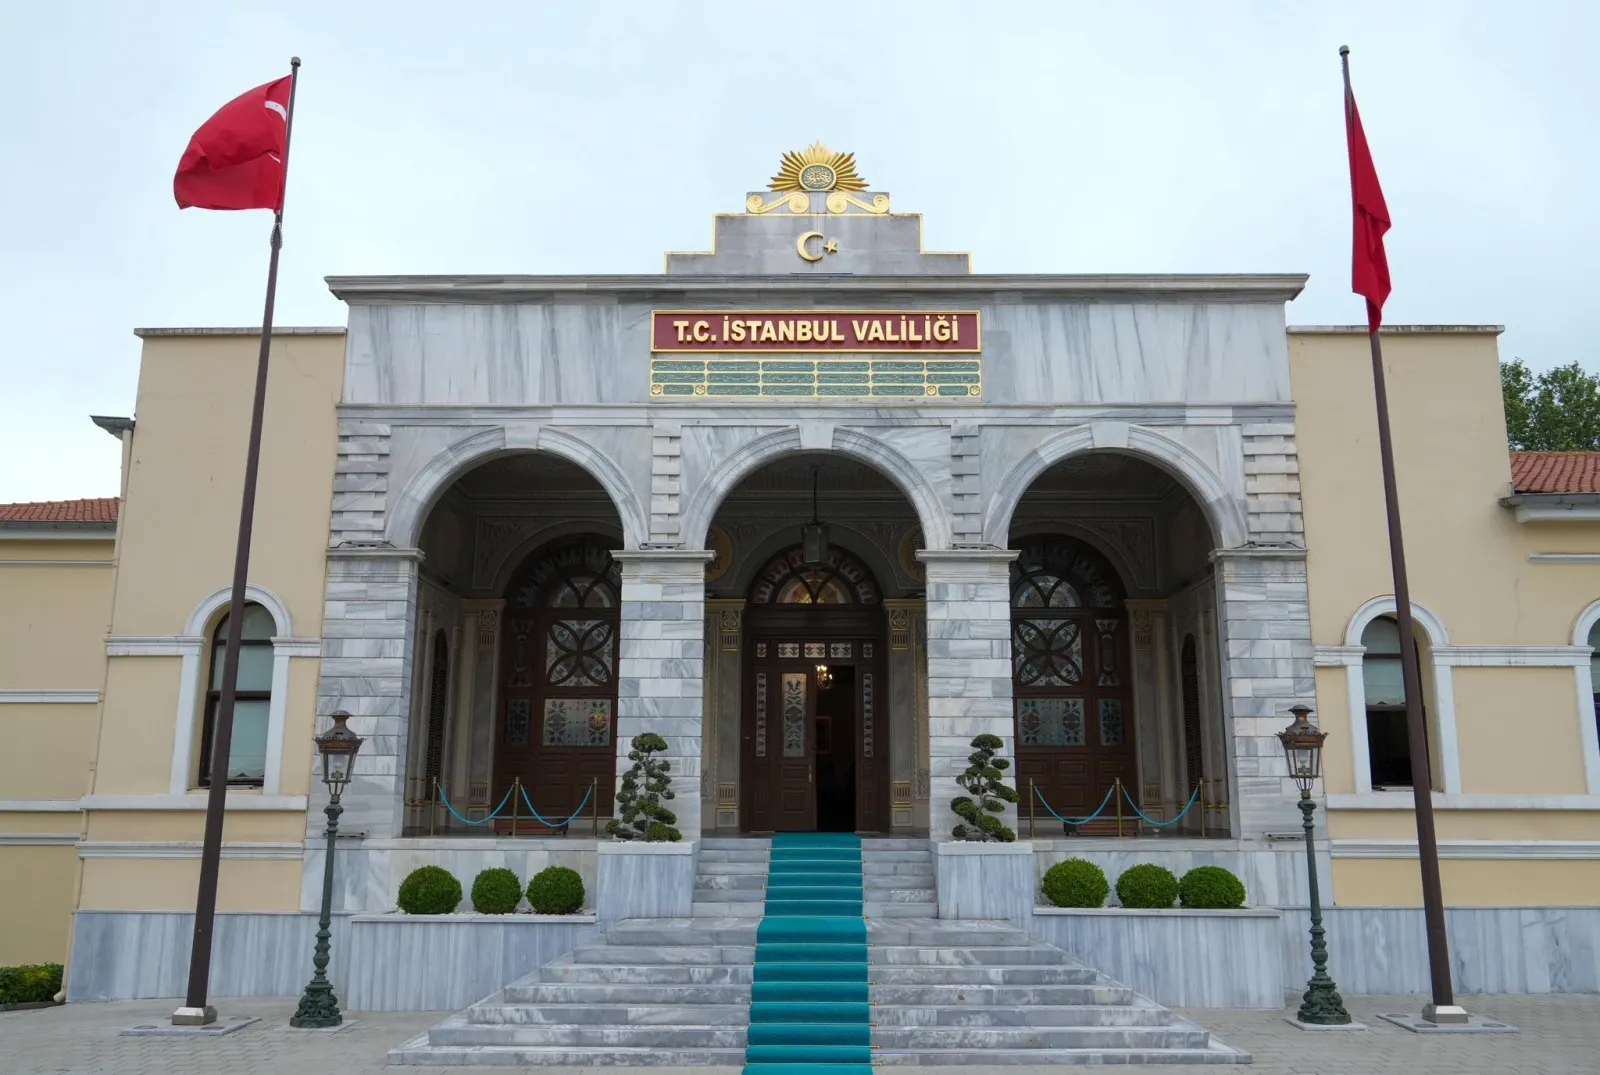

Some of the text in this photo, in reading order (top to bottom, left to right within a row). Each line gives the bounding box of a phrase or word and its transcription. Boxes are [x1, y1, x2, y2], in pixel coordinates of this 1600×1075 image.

[673, 315, 959, 341] T.C. İSTANBUL VALİLİĞİ
